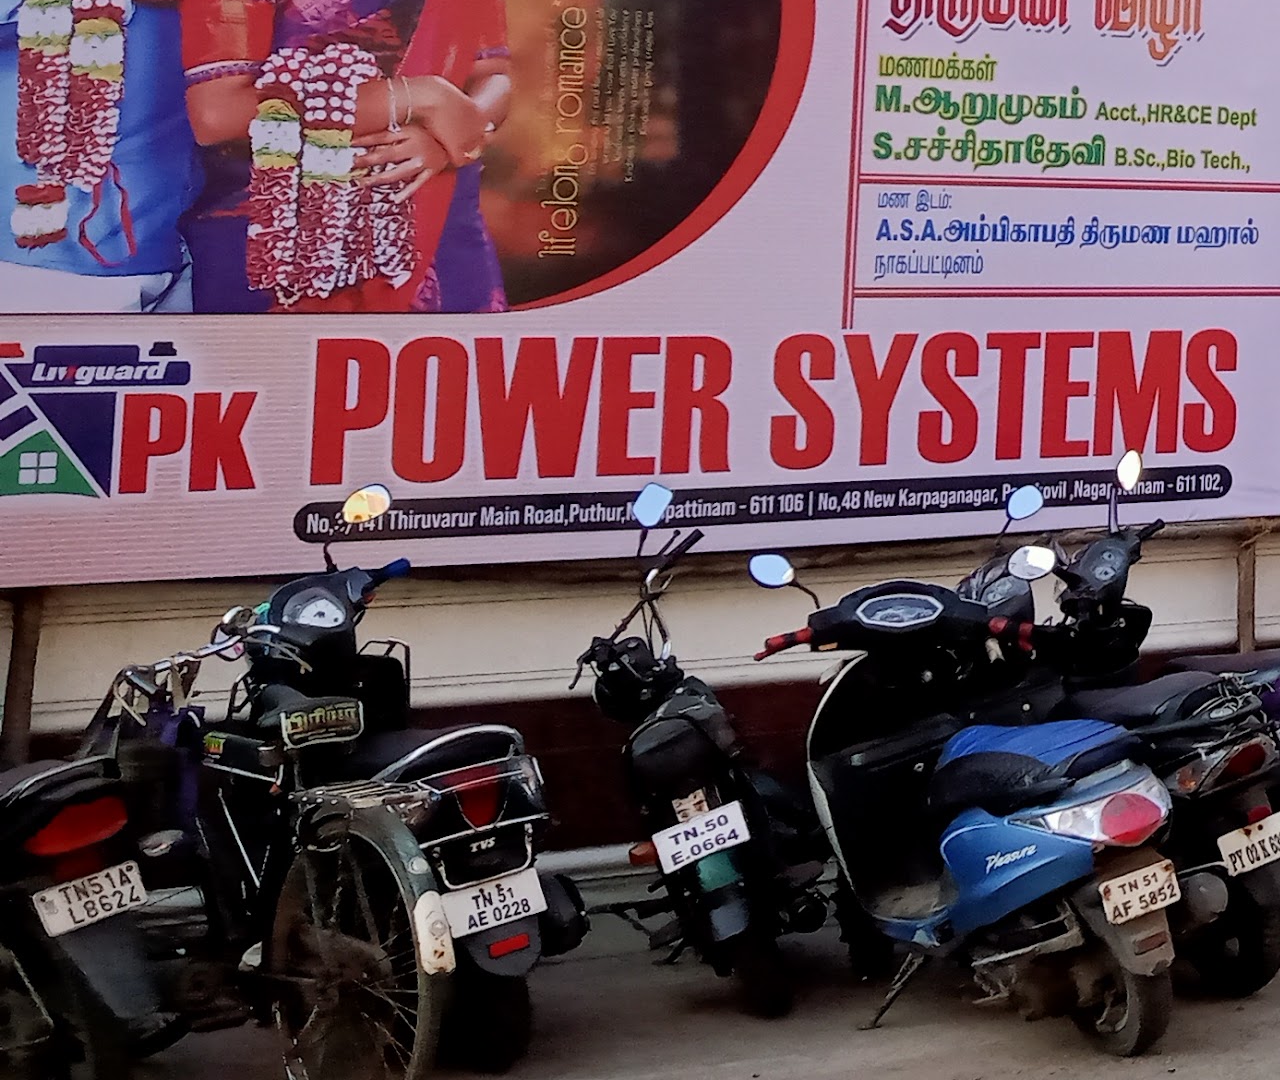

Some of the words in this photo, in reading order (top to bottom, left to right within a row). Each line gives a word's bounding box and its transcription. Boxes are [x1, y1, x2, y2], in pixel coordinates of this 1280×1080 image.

[555, 6, 587, 134] romance
[878, 52, 997, 82] மணமக்கள்
[875, 85, 1087, 125] M.ஆறுமுகம்
[1217, 106, 1257, 128] Dept
[872, 127, 1106, 172] S.சச்சிதாதேவி
[1200, 150, 1251, 172] Tech.,
[877, 191, 910, 210] மண
[915, 188, 952, 213] இடம்:
[1080, 217, 1170, 250] திருமண
[1177, 217, 1259, 250] மஹால்
[874, 249, 984, 280] நாகப்பட்டினம்
[118, 392, 258, 494] PK
[310, 336, 733, 486] POWER
[770, 328, 1238, 470] SYSTEMS
[387, 510, 477, 531] Thiruvarur
[479, 506, 518, 527] Main
[750, 495, 775, 515] 611
[779, 493, 804, 514] 106
[817, 491, 861, 513] No,48
[863, 490, 895, 509] New
[899, 487, 999, 510] Karpaganagar,
[1176, 475, 1196, 493] 611
[1199, 473, 1224, 493] 102,
[469, 837, 496, 853] TVS
[668, 814, 728, 845] TN.50
[671, 828, 739, 866] E.0664
[984, 842, 1037, 874] Pleasure
[1228, 849, 1245, 872] PY
[1245, 843, 1260, 865] 02
[58, 868, 132, 905] TN51A
[472, 891, 494, 910] TN
[497, 887, 514, 903] 51
[1118, 879, 1139, 896] TN
[1142, 871, 1159, 888] 51
[468, 911, 489, 930] AE
[493, 898, 531, 921] 0228
[1111, 903, 1133, 921] AF
[1138, 883, 1177, 915] 5852
